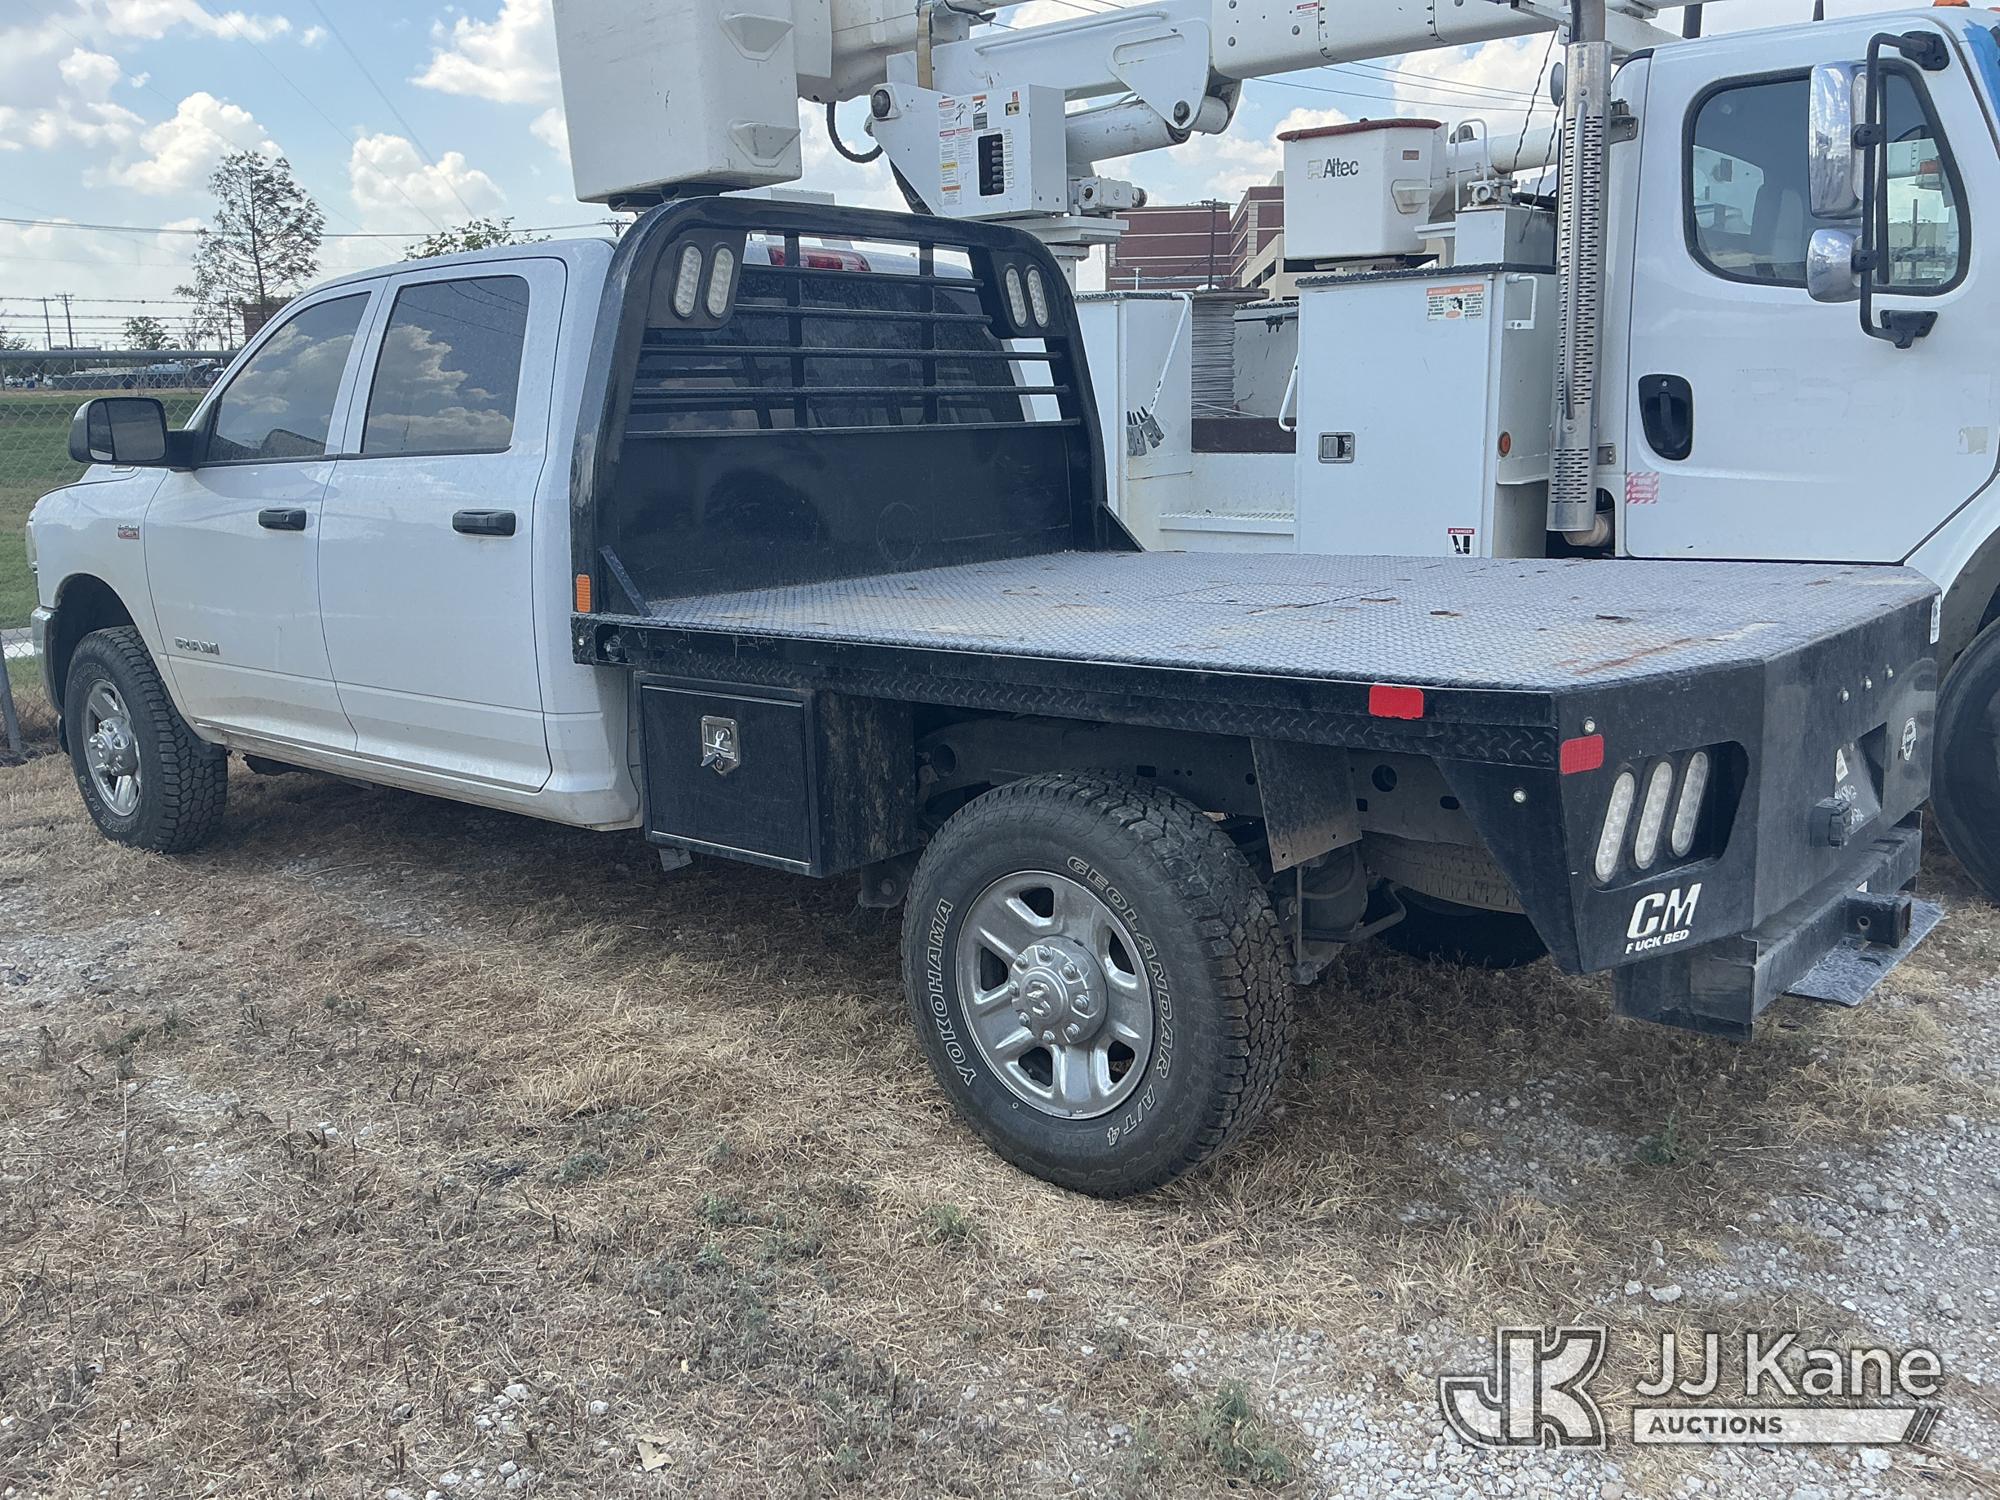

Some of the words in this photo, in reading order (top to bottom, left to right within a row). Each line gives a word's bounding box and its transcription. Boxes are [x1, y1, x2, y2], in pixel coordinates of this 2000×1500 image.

[1323, 158, 1359, 178] Altec
[1626, 882, 1702, 939] CM
[1662, 929, 1690, 945] BED
[927, 898, 977, 1087] YOKOHAMA
[1066, 855, 1174, 1079] GEOLANDAR
